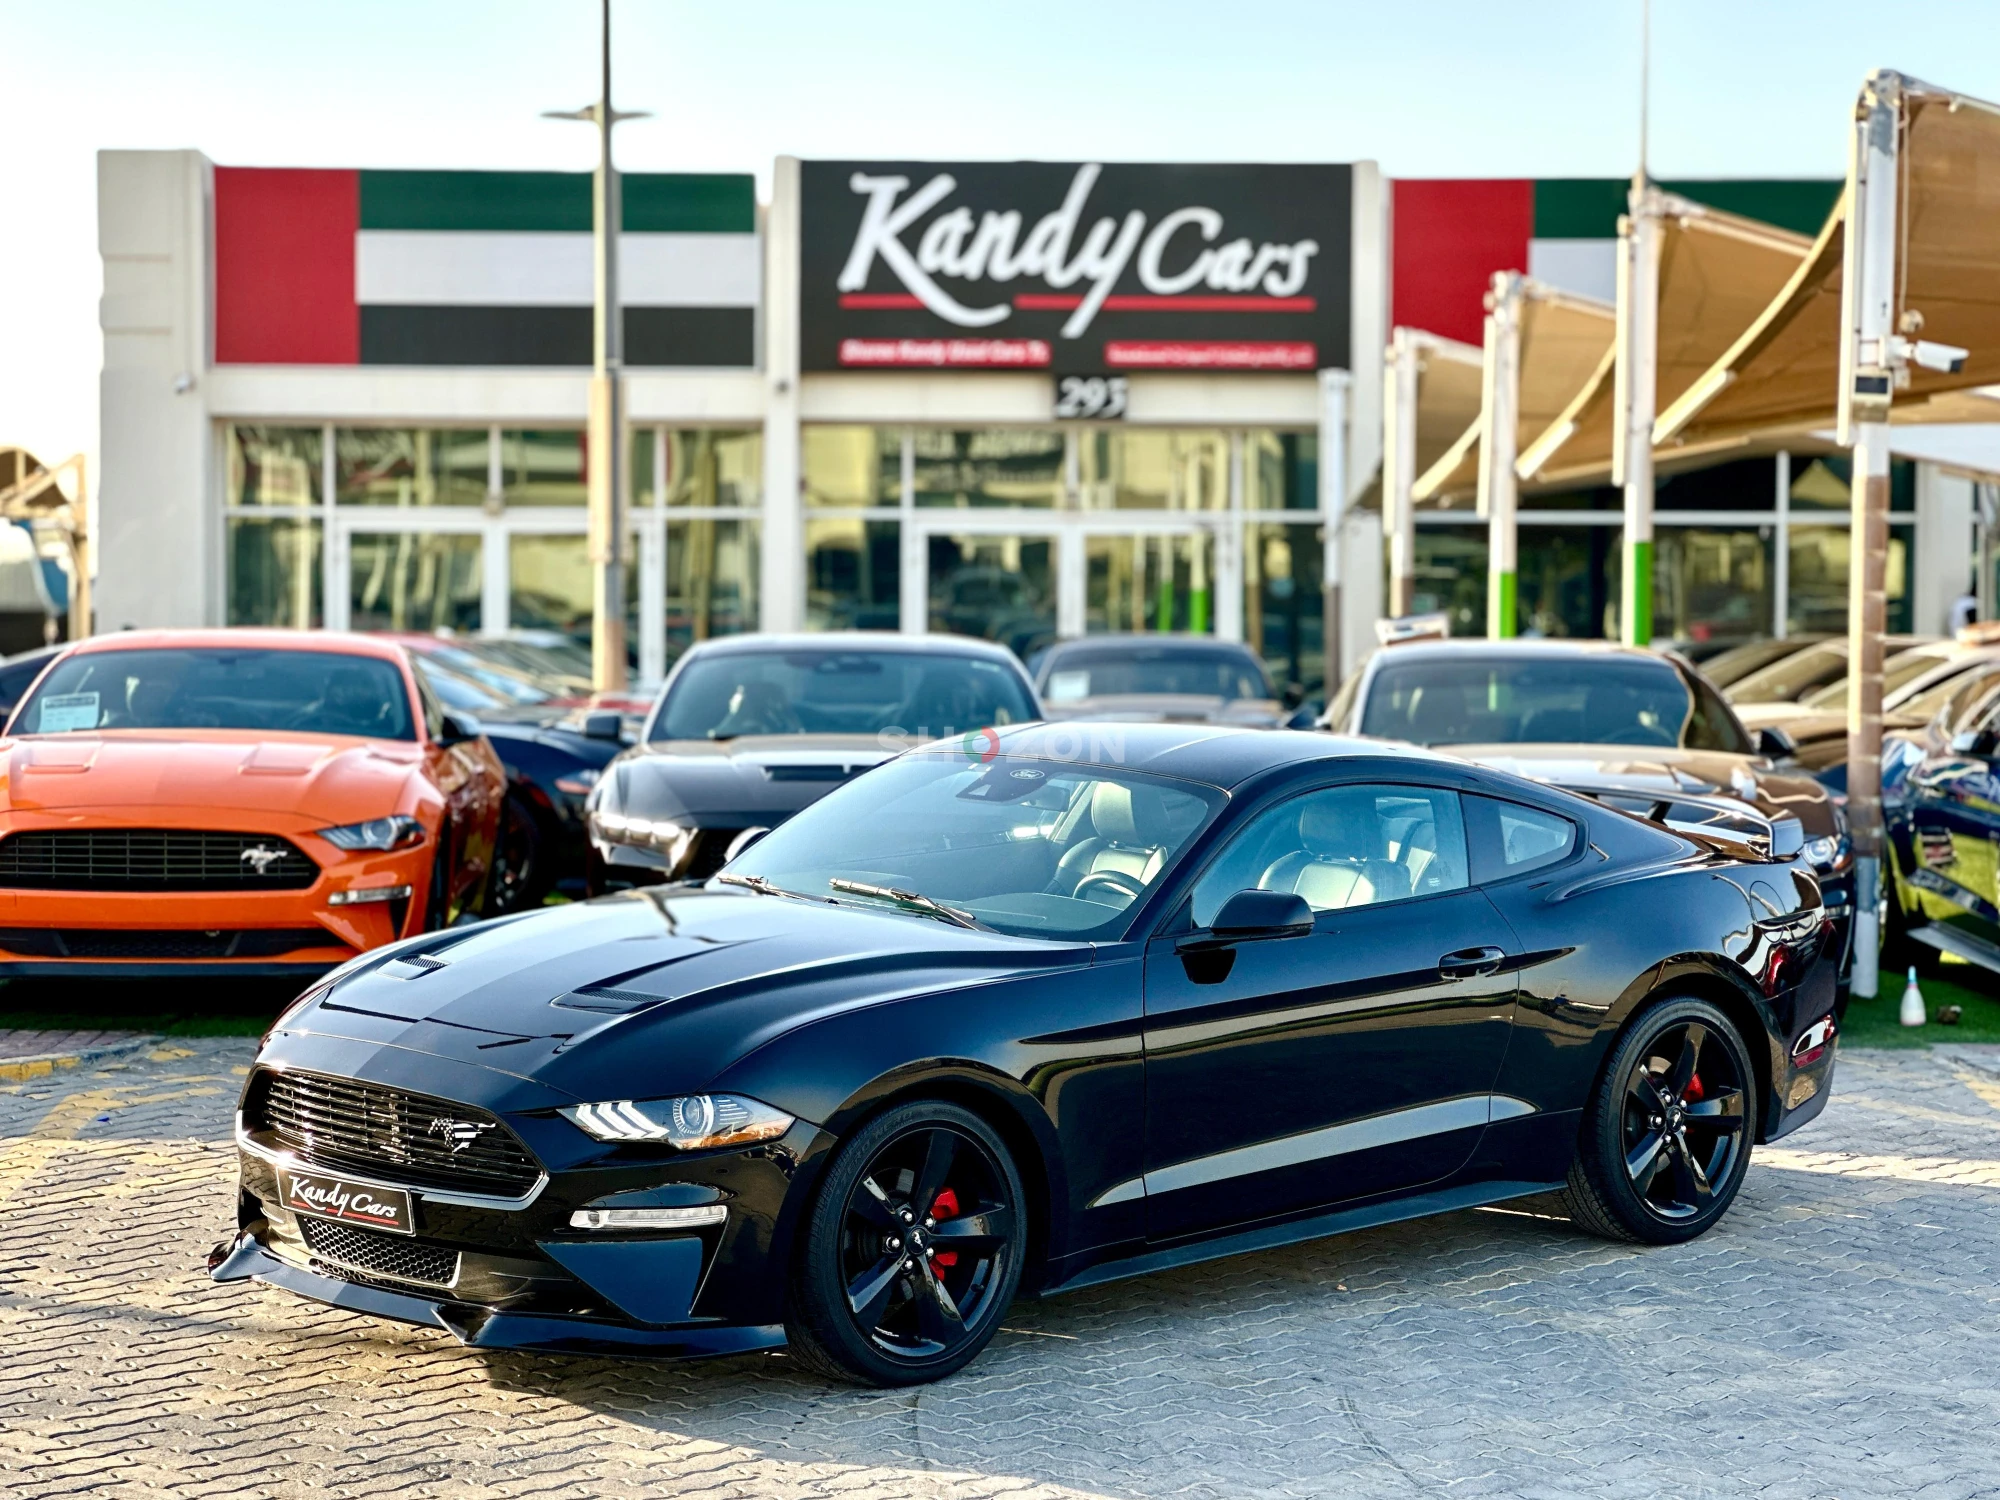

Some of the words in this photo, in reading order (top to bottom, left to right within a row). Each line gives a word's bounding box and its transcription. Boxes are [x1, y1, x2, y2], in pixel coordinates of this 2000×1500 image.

[837, 161, 1146, 339] Kandy
[1136, 205, 1319, 296] Cars
[288, 1174, 351, 1217] Kandy
[350, 1193, 398, 1218] Cars
